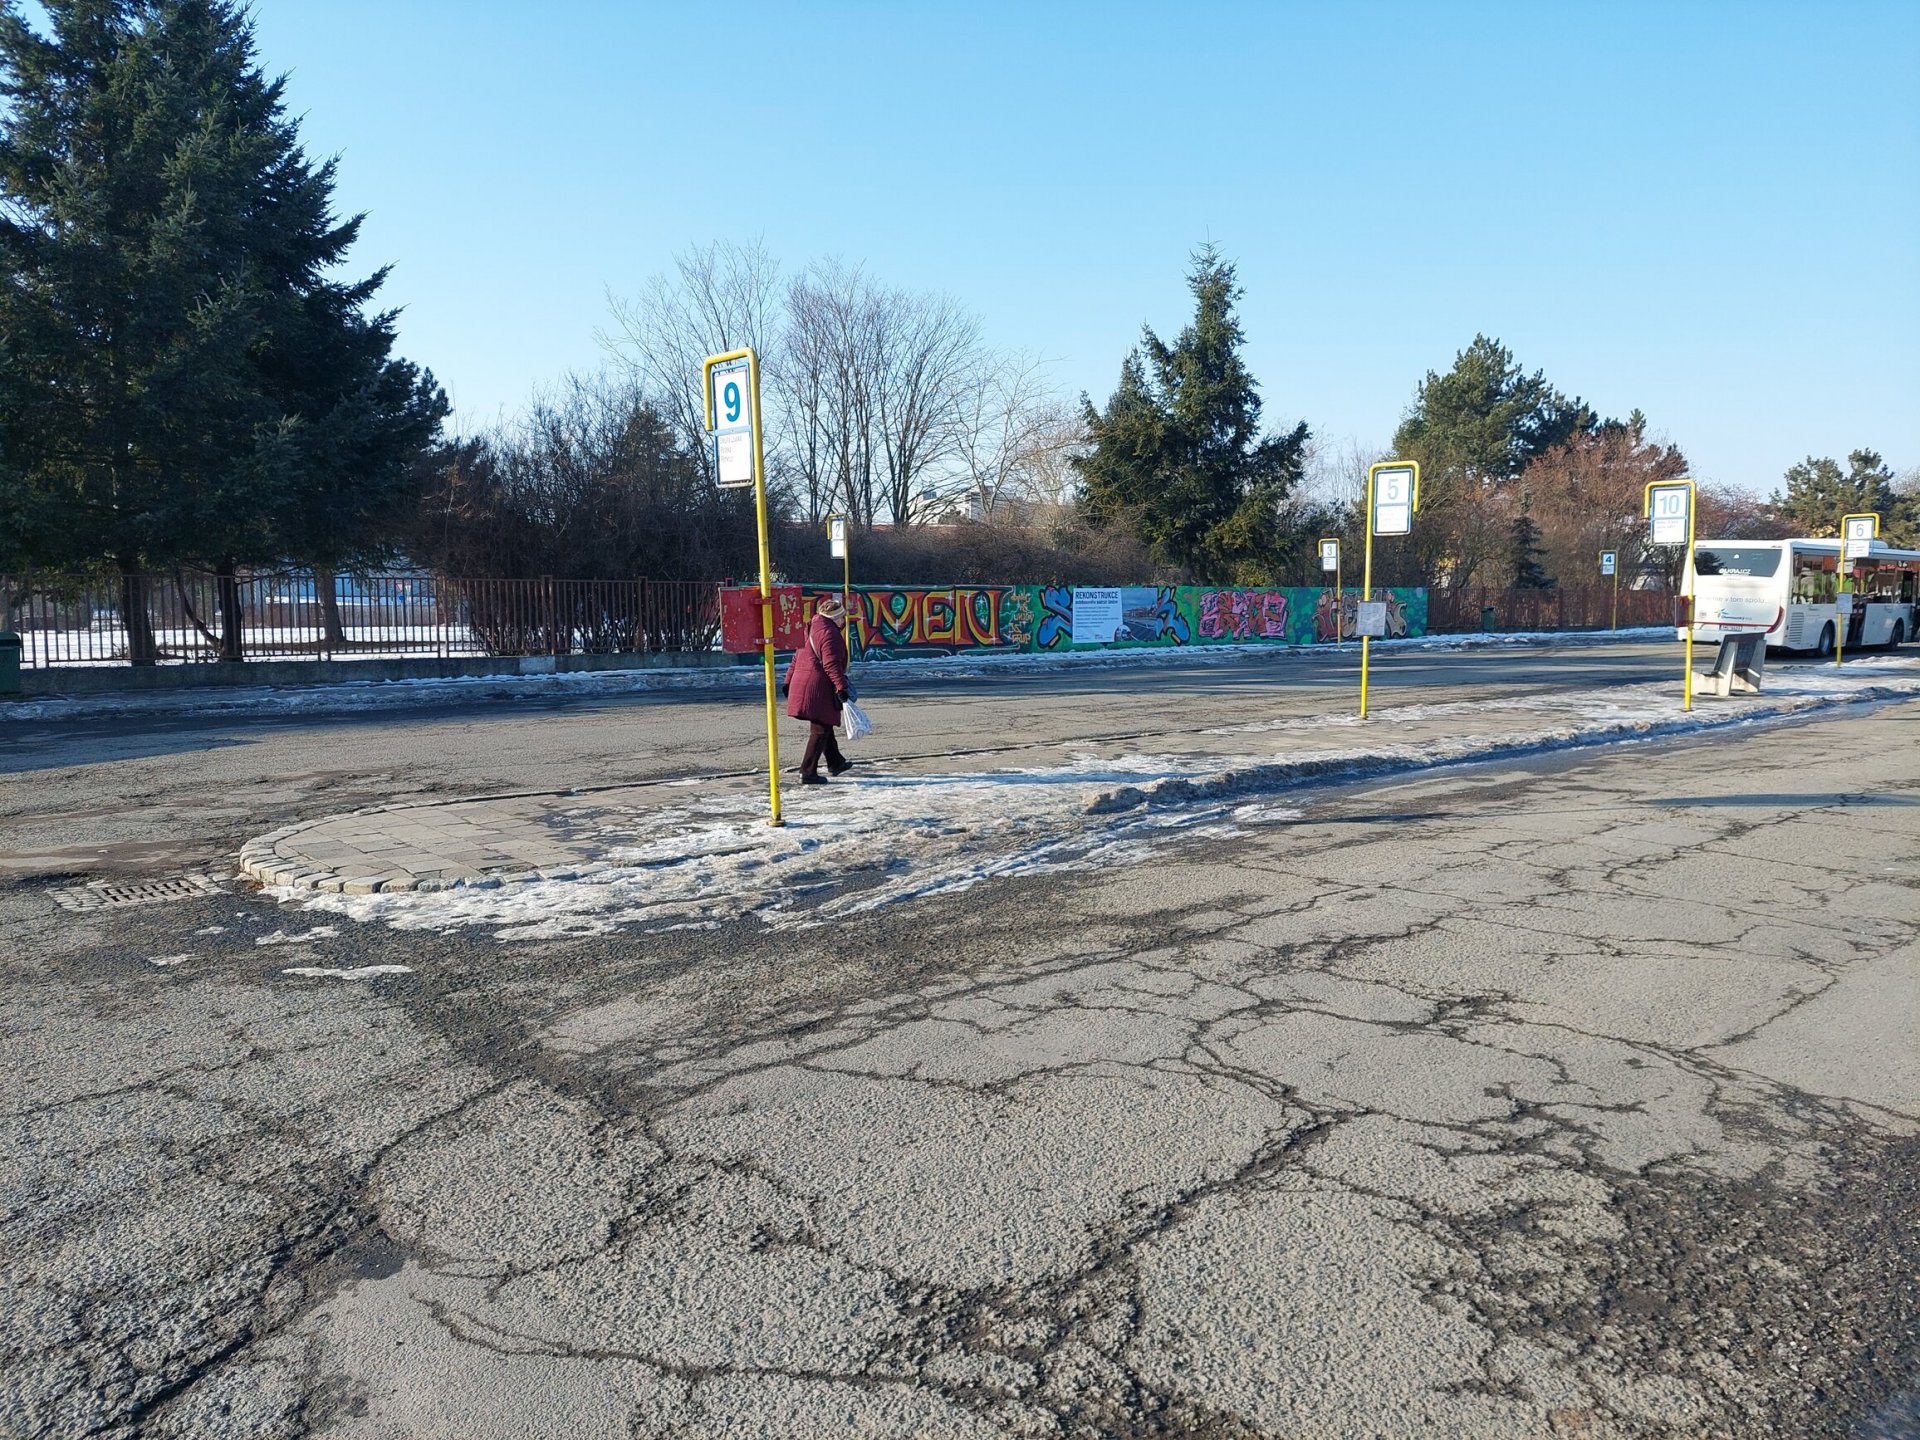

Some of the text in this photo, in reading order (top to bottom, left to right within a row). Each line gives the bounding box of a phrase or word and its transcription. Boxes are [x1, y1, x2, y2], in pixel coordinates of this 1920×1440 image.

[724, 382, 741, 423] 9
[1387, 478, 1399, 500] 5
[1659, 495, 1680, 515] 10
[835, 523, 841, 537] 2
[1856, 523, 1864, 537] 6
[1327, 545, 1333, 556] 3
[1605, 555, 1612, 563] 4
[1075, 591, 1119, 600] REKONSTRUKCE
